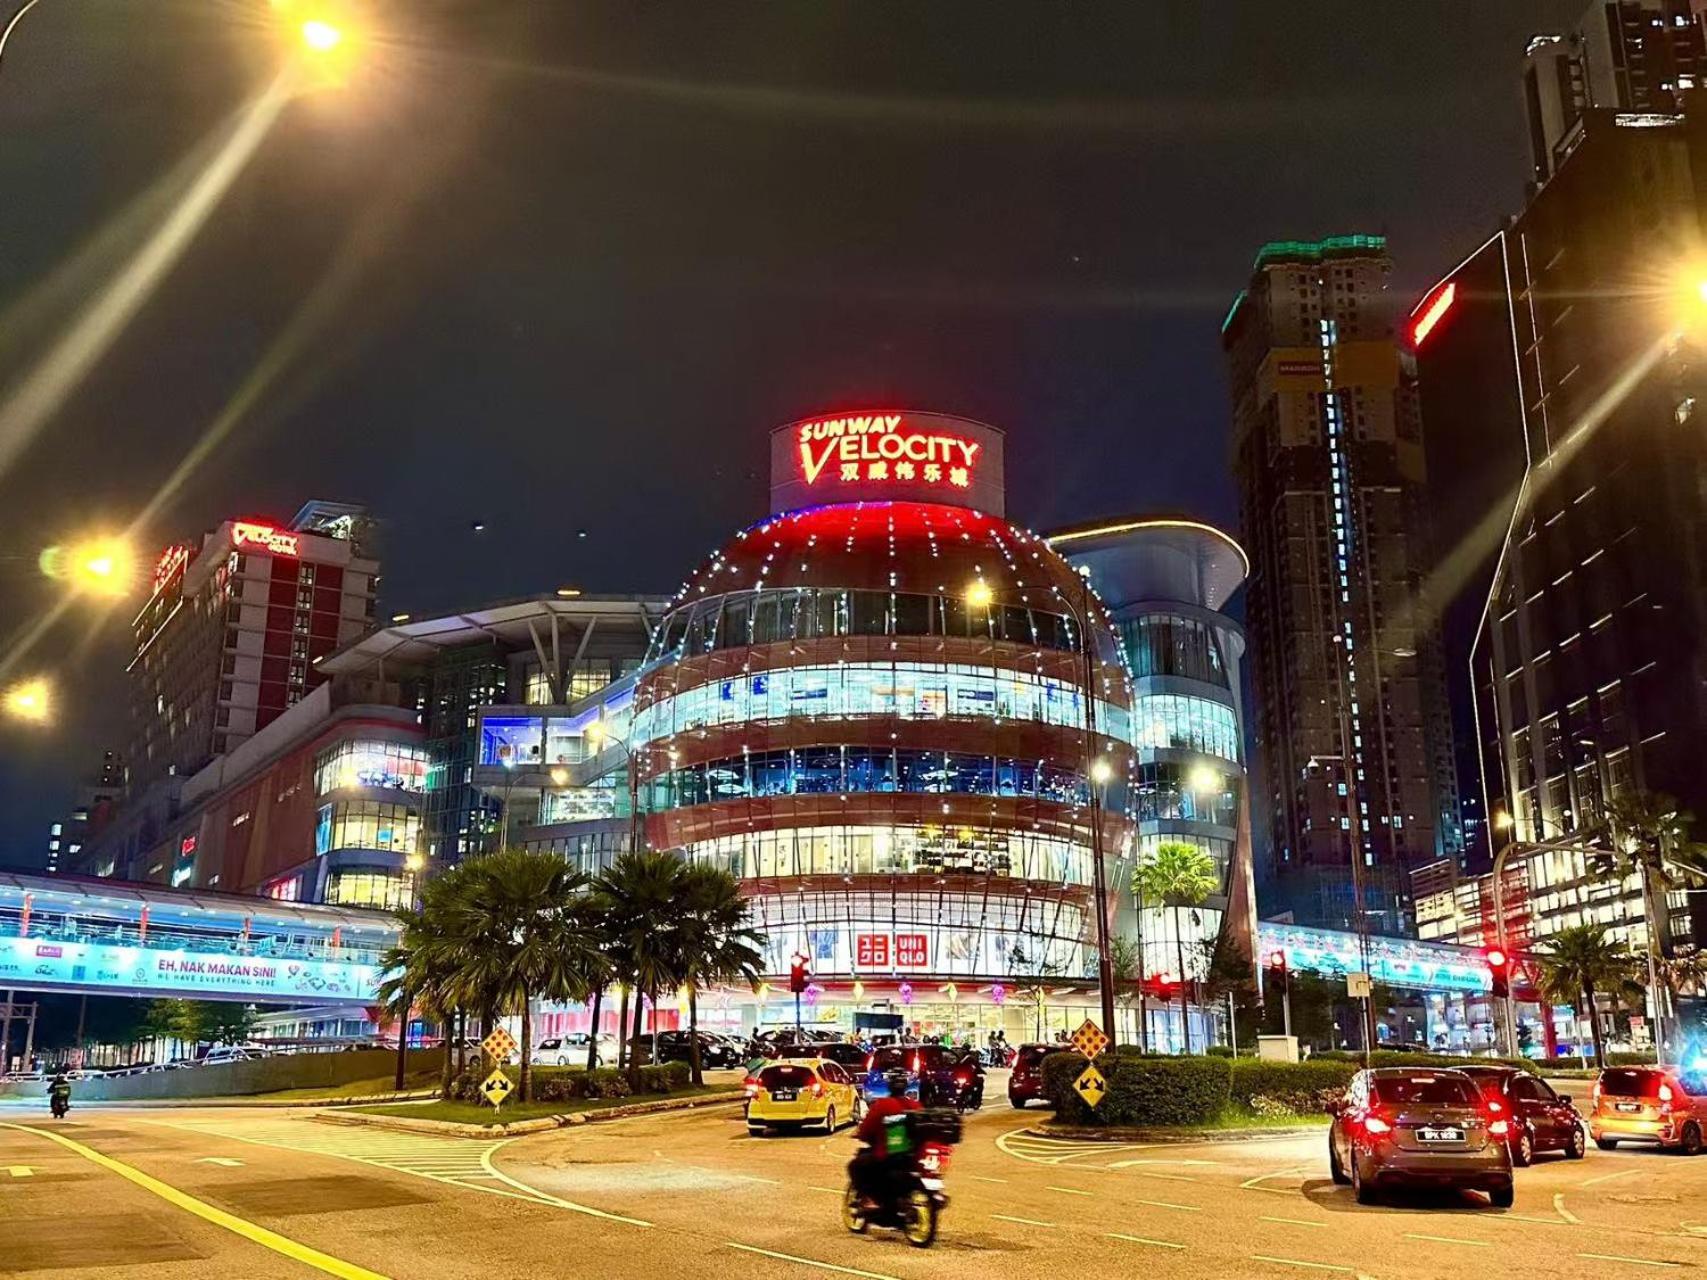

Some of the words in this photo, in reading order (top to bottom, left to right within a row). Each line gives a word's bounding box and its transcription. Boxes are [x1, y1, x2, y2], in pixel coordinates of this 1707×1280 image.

[800, 415, 901, 443] SUNWAY
[800, 434, 979, 485] VELOCITY
[899, 937, 923, 950] UNI
[899, 951, 925, 965] QLO
[158, 959, 178, 974] EH,
[180, 961, 206, 974] NAK
[207, 963, 251, 977] MAKAN
[252, 966, 277, 979] SINI!
[174, 974, 196, 983] HAVE
[199, 976, 252, 986] EVERYTHING
[255, 979, 276, 987] HERE
